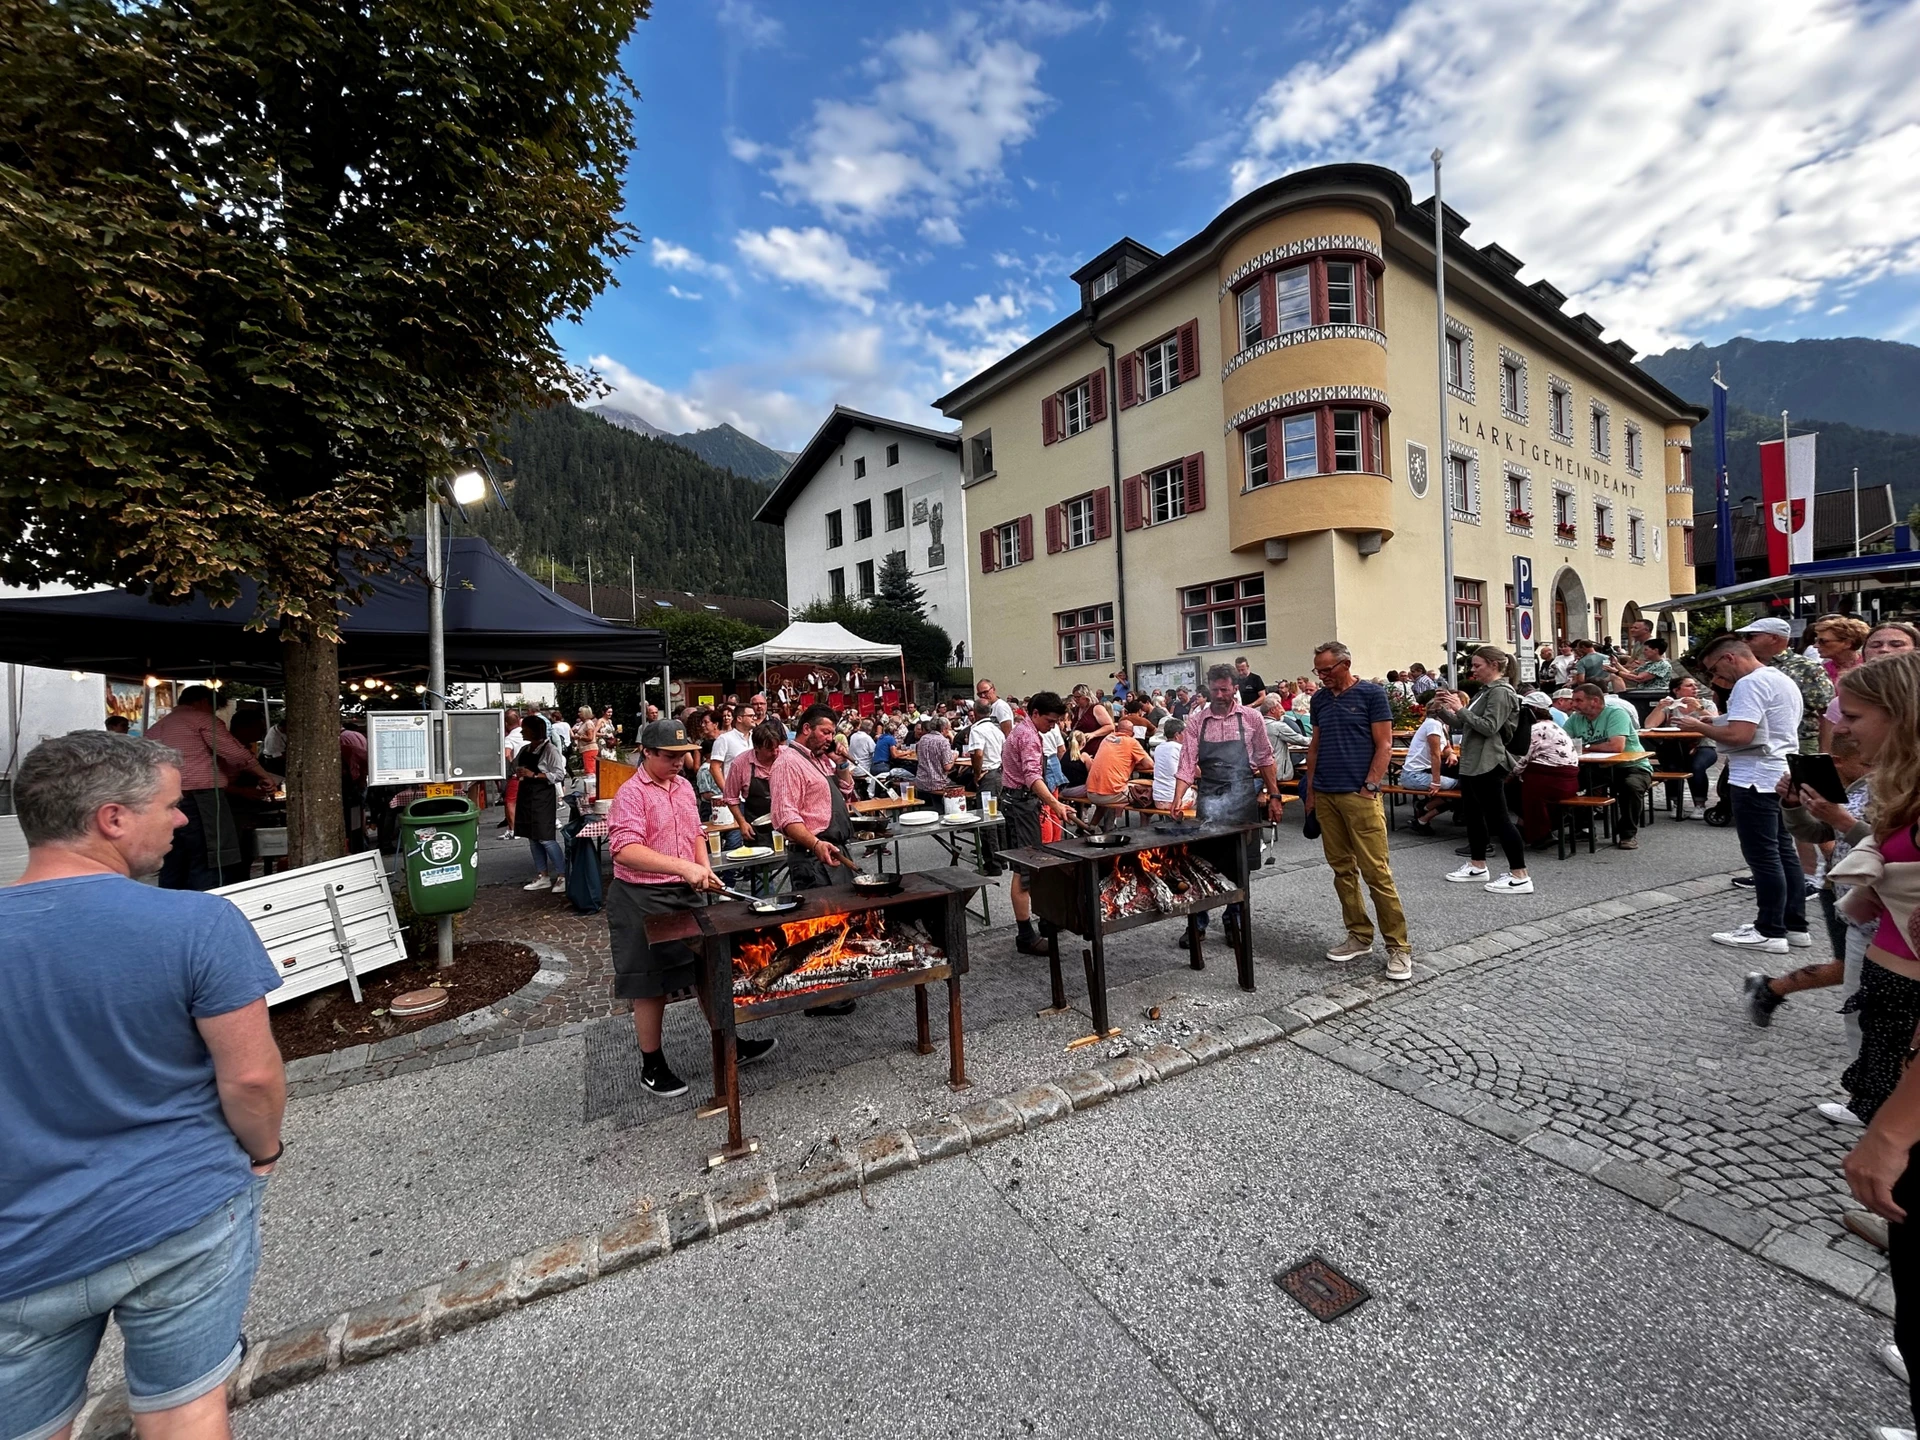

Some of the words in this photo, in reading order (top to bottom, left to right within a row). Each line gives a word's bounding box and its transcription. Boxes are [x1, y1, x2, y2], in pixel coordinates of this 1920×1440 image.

[1459, 412, 1635, 499] MARKTGEMEINDEAMT
[1520, 559, 1529, 593] P
[435, 787, 442, 795] S
